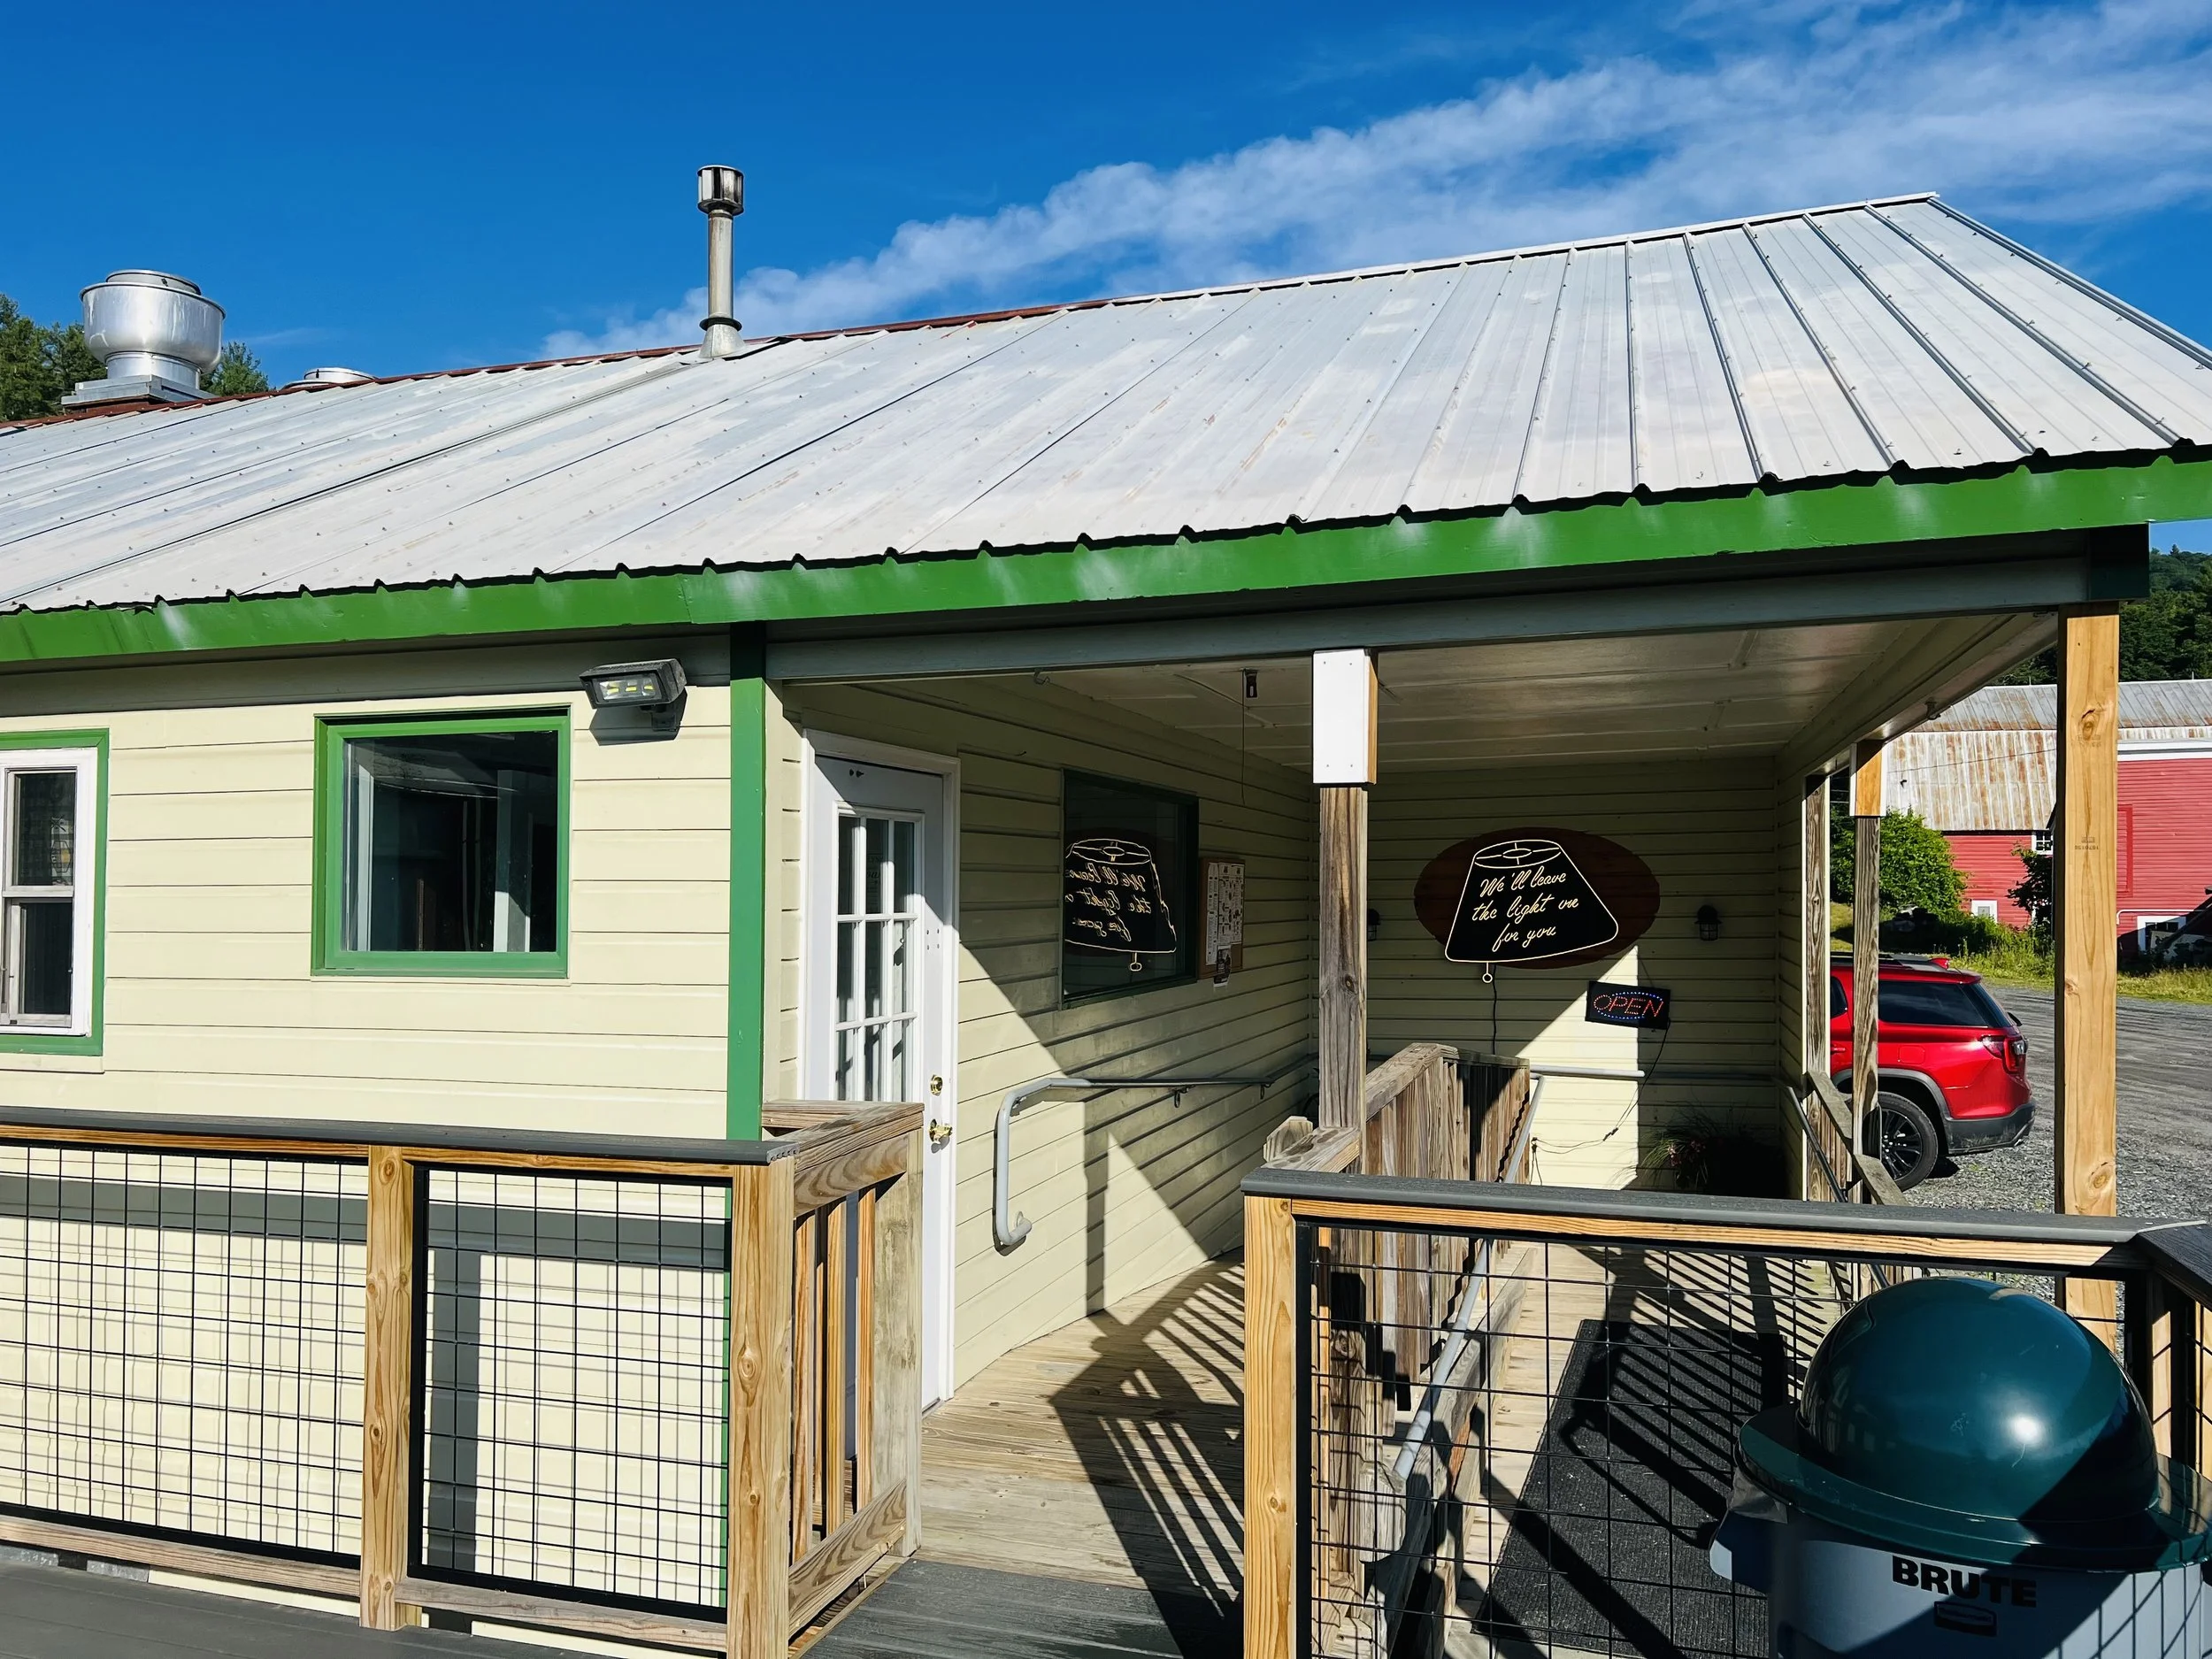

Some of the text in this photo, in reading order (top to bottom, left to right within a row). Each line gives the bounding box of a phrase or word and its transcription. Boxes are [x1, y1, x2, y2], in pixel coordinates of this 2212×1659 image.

[1480, 865, 1567, 897] We'll leave
[1471, 893, 1579, 925] the light on
[1492, 923, 1556, 953] for you
[1594, 994, 1664, 1018] OPEN
[1892, 1555, 2037, 1608] BRUTE
